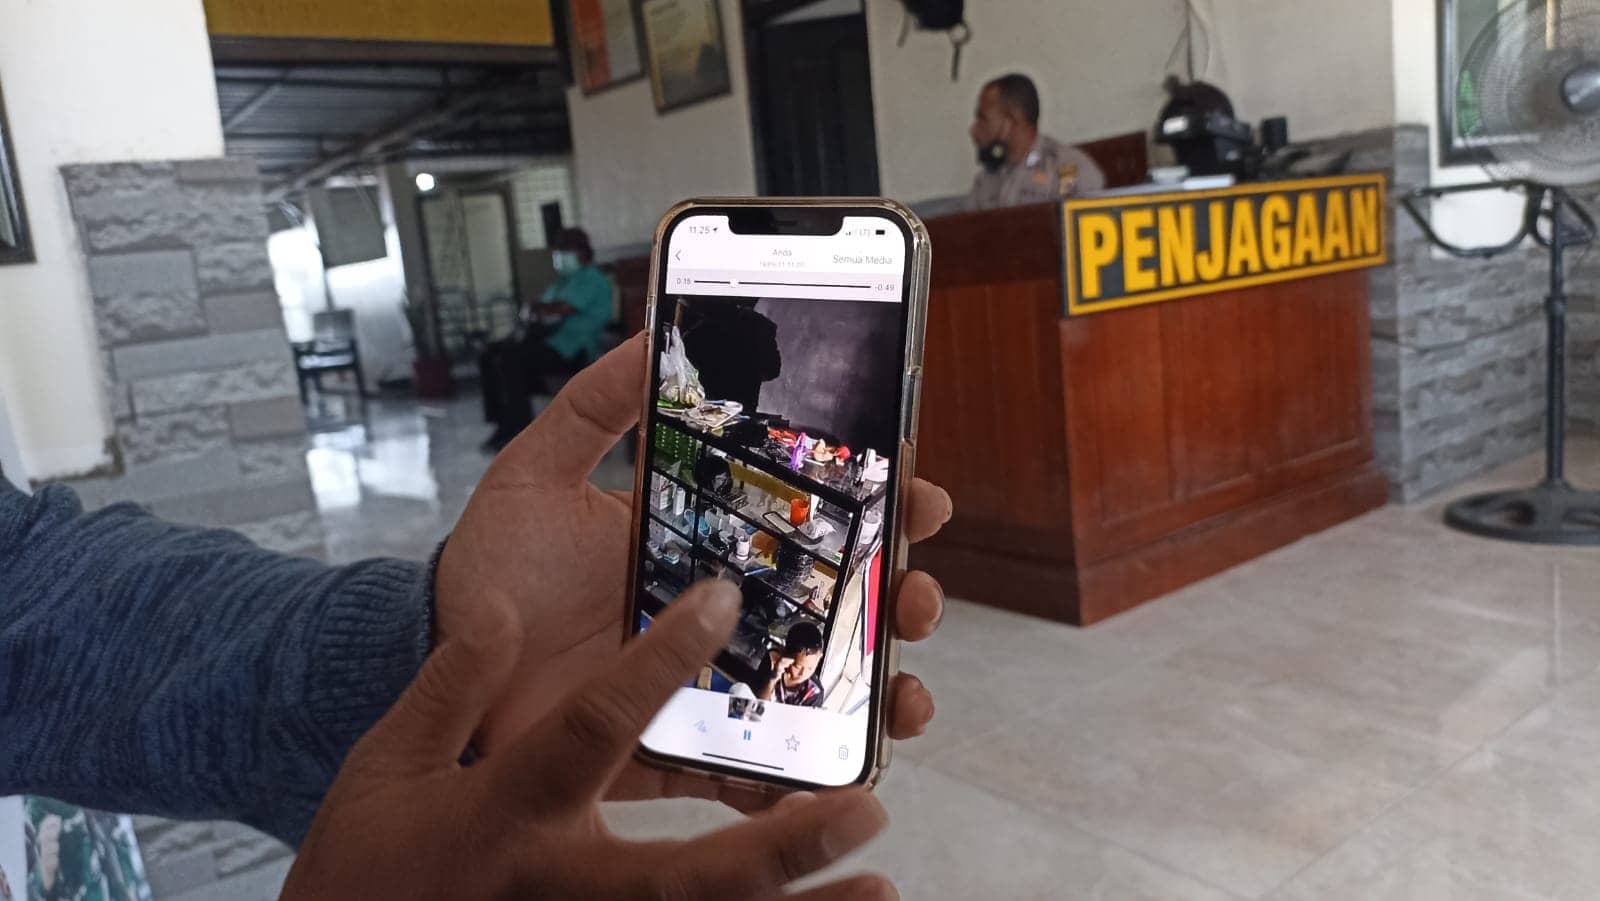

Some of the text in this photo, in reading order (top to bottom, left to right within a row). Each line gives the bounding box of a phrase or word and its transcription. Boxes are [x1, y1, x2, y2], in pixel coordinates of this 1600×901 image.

[832, 254, 893, 265] Semua Media
[1078, 187, 1378, 299] PENJAGAAN
